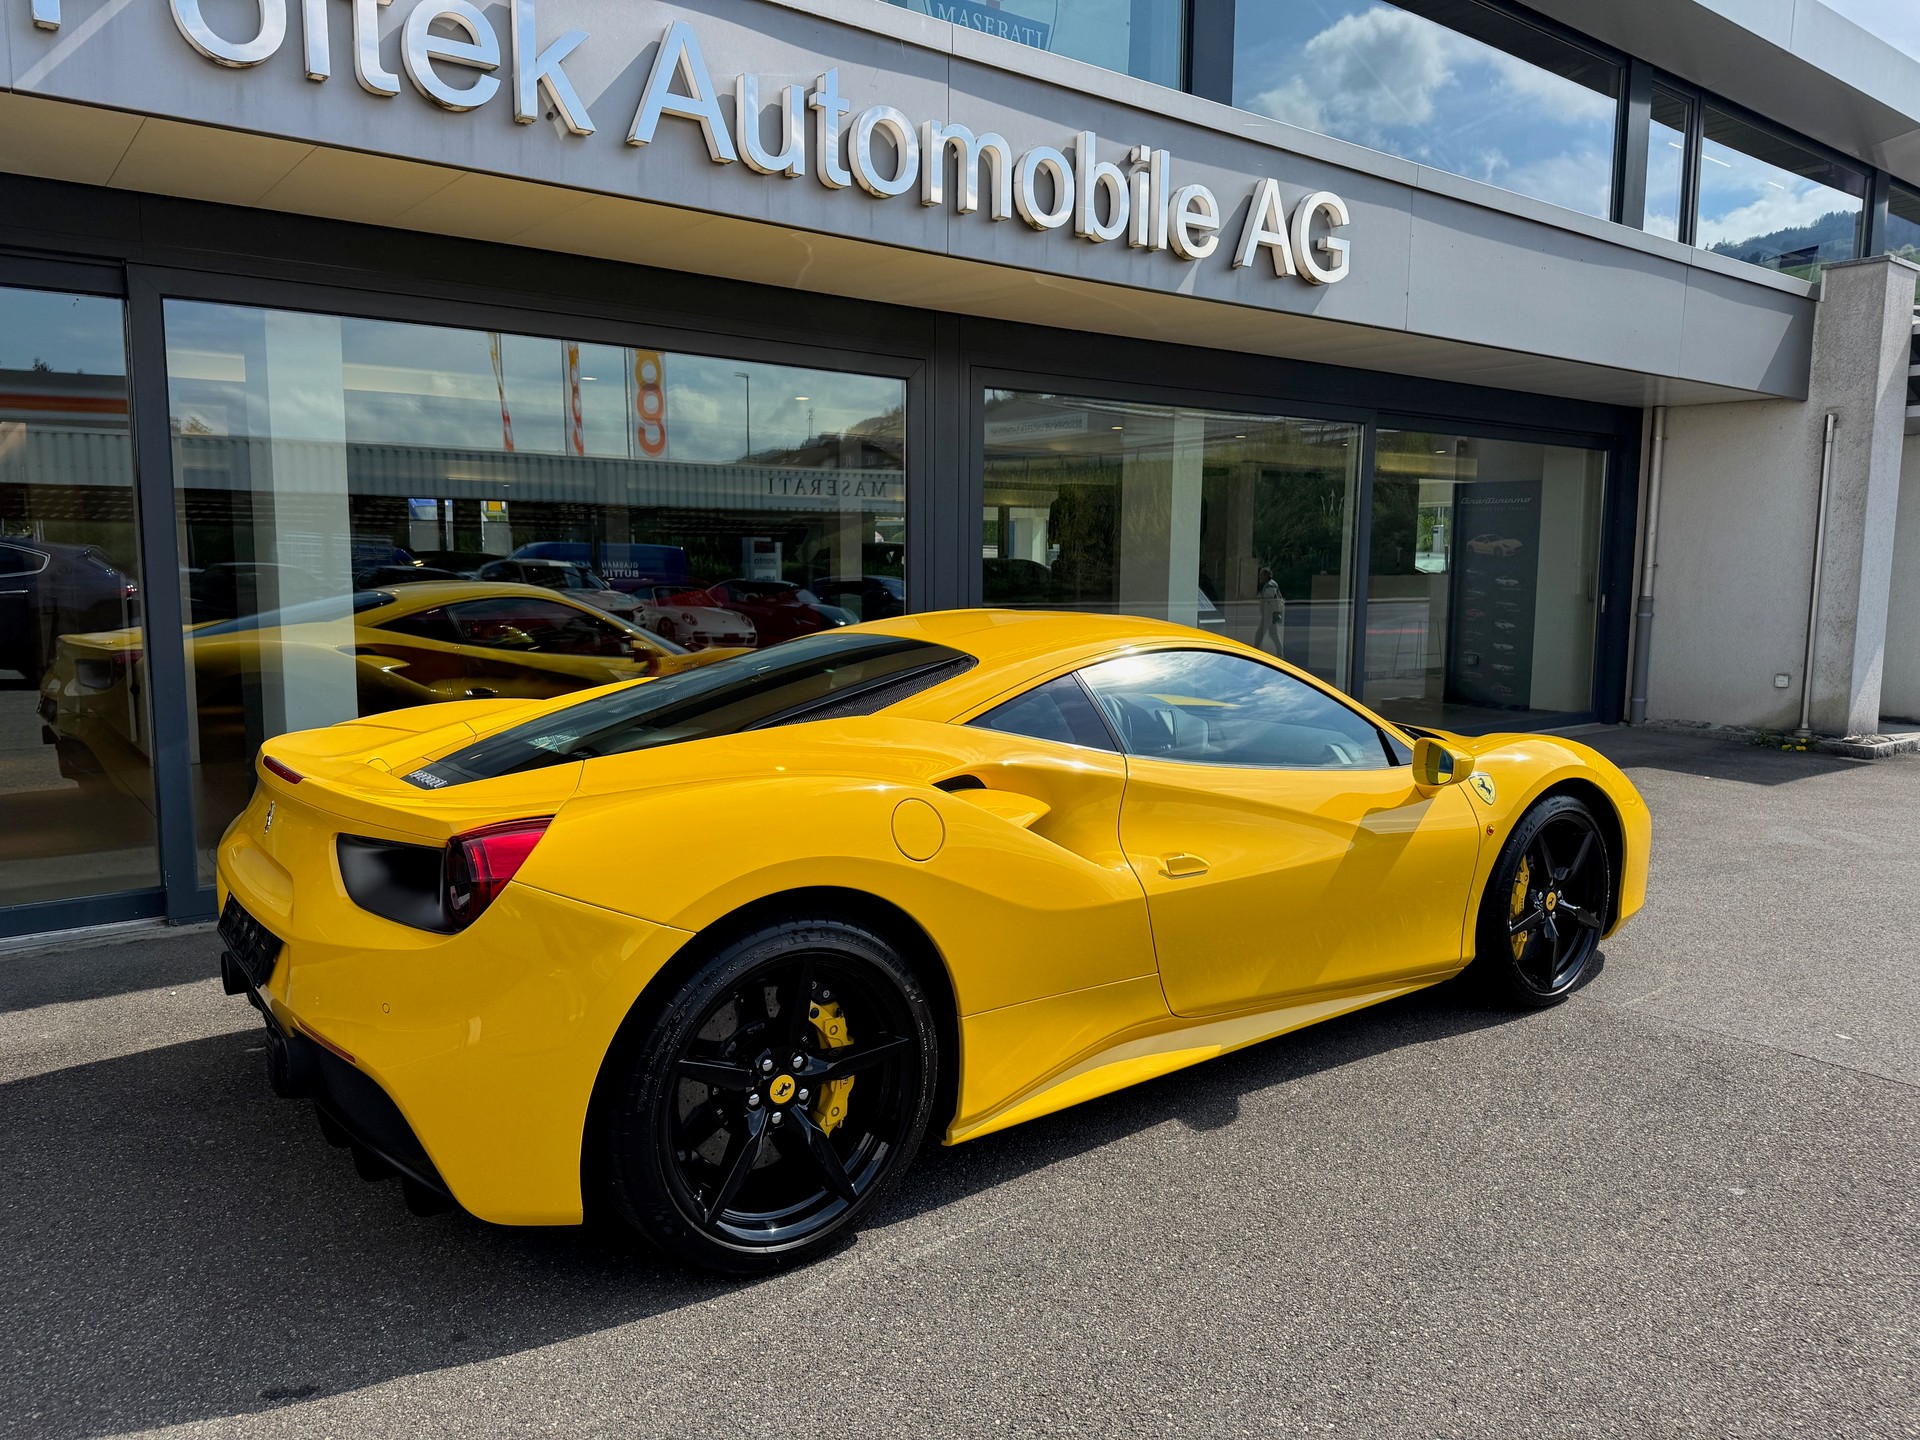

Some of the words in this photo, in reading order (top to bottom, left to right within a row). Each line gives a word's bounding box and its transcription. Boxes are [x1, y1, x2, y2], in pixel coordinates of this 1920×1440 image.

[937, 2, 1044, 50] MASERATI
[32, 0, 597, 136] otek
[625, 19, 1220, 260] Automobile
[1232, 177, 1350, 286] AG
